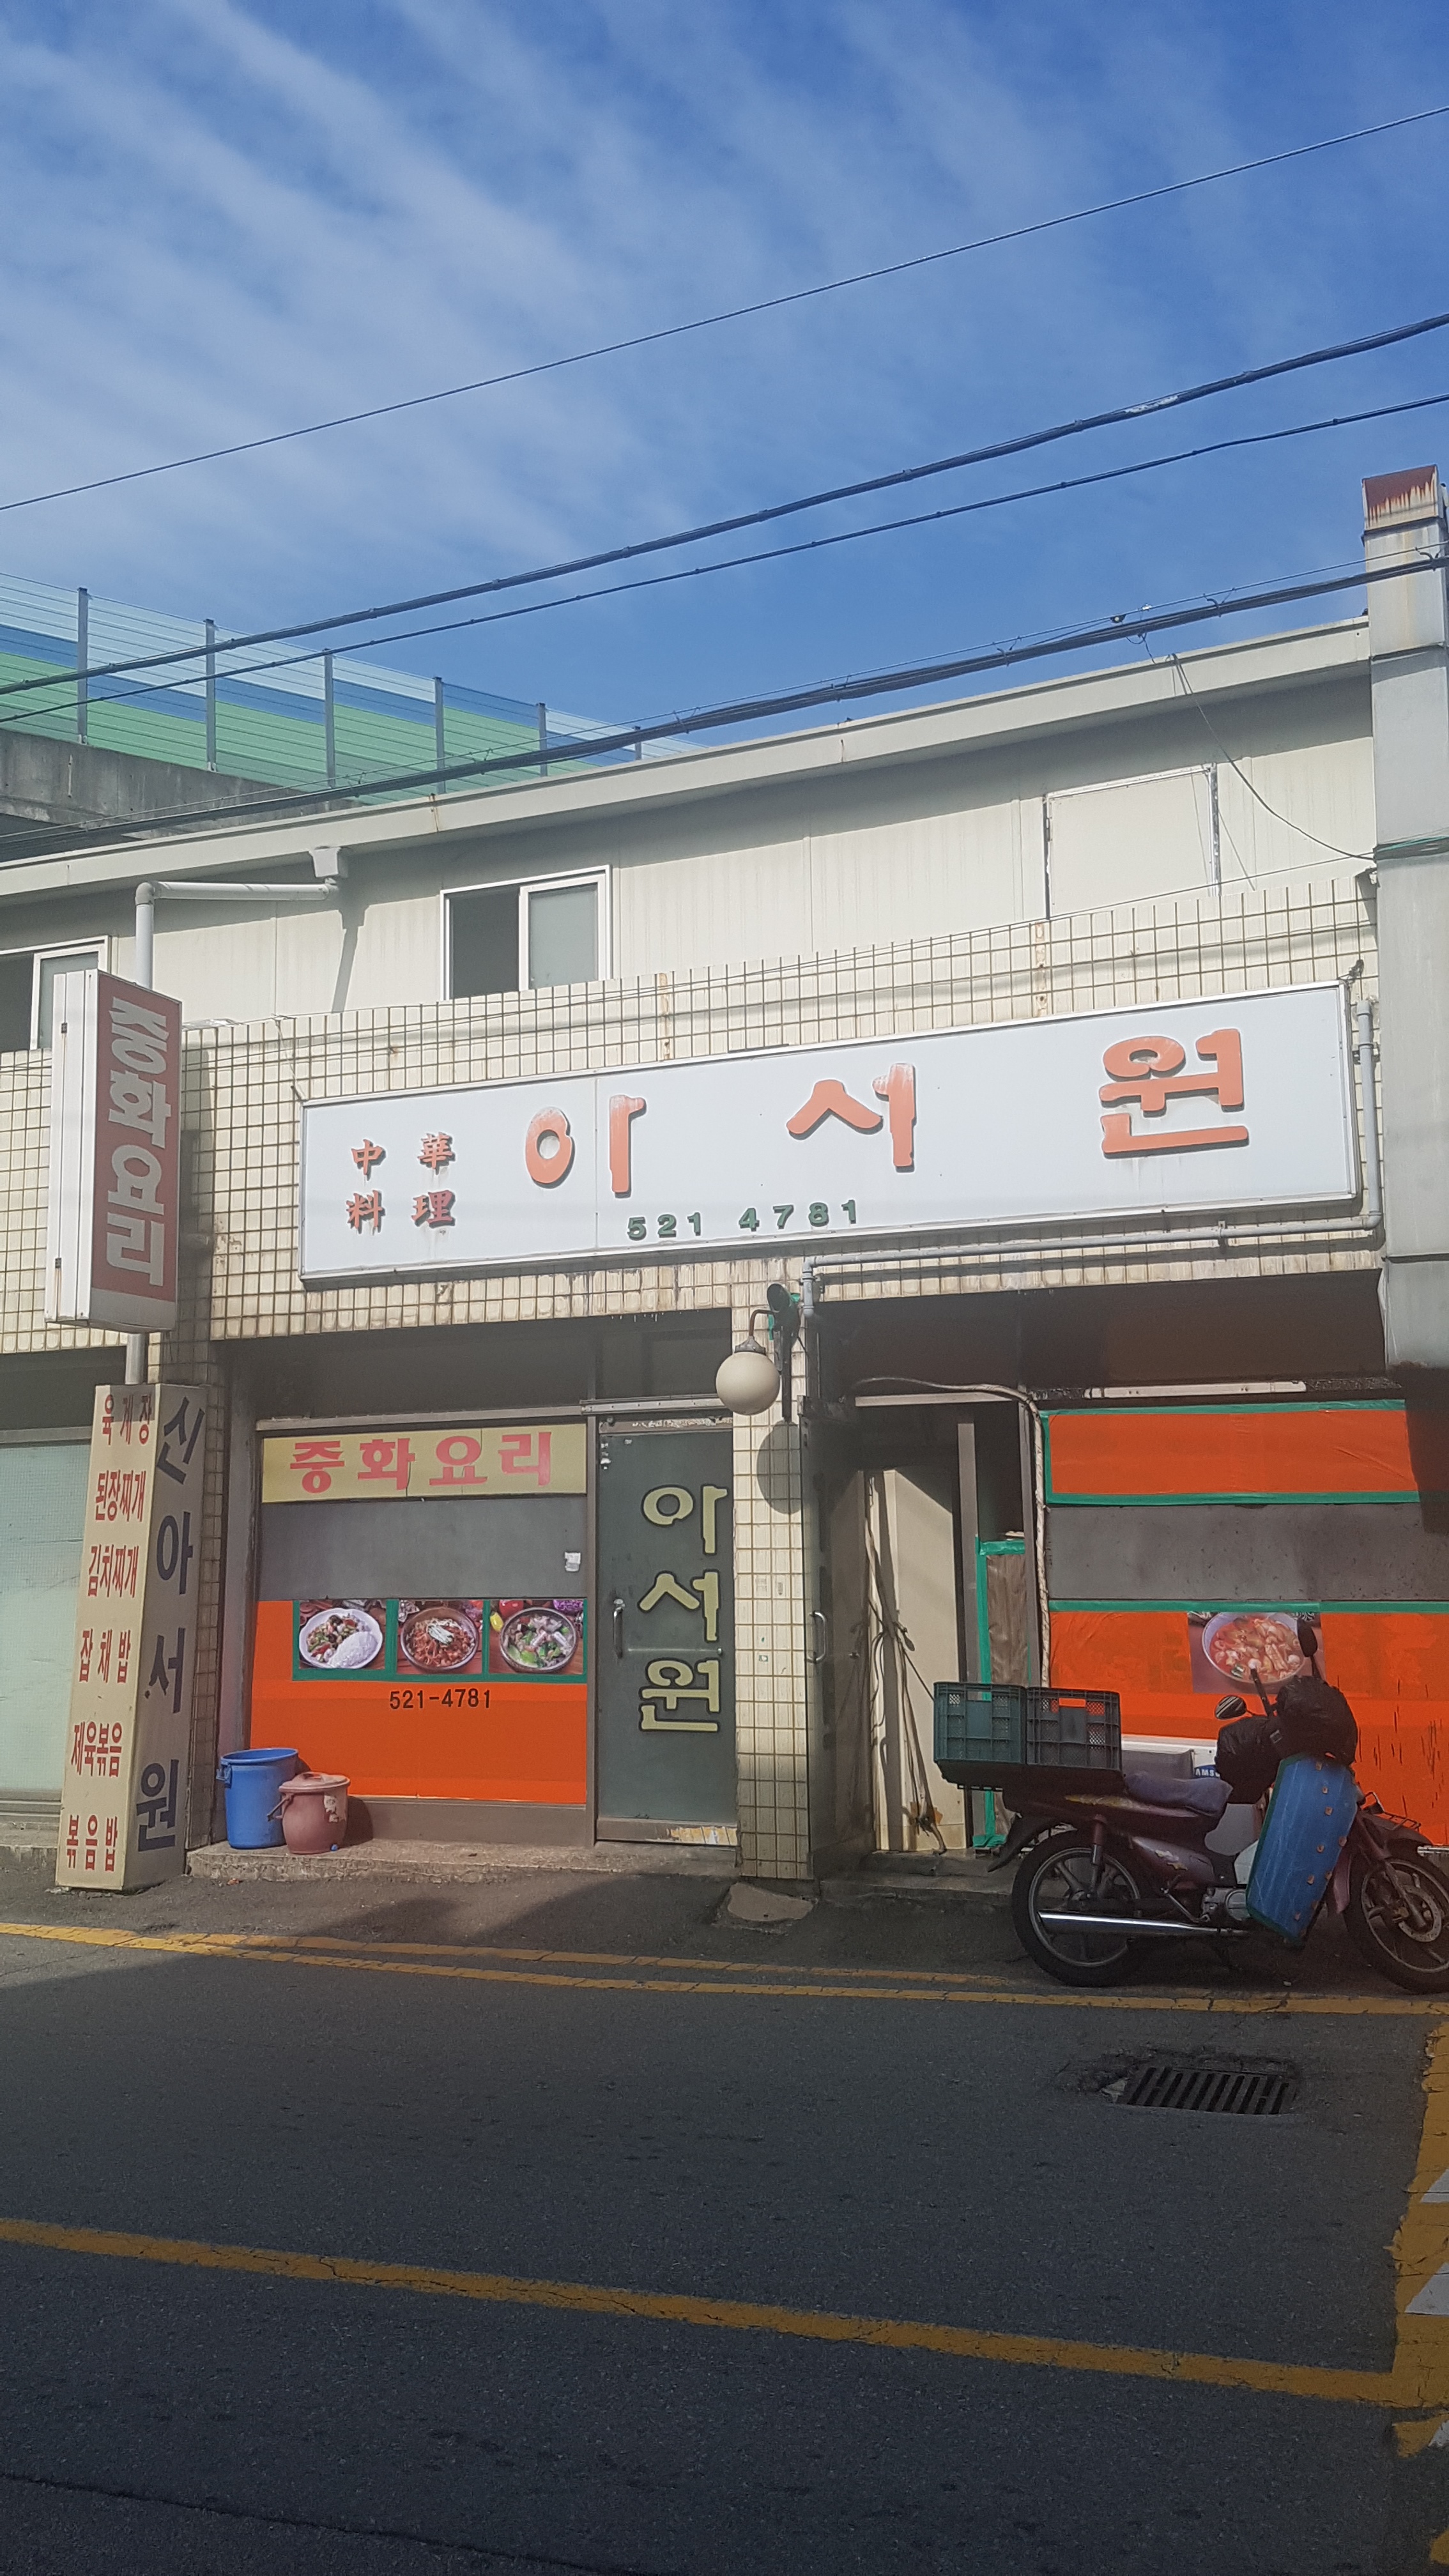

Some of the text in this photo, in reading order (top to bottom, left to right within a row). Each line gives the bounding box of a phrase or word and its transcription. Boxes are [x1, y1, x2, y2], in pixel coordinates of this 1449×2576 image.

[106, 997, 171, 1286] 중화요리
[351, 1131, 455, 1181] 中華
[346, 1190, 455, 1233] 料理
[627, 1199, 857, 1241] 521 4781
[289, 1432, 552, 1494] 중화요리
[95, 1469, 146, 1522] 된장찌개
[88, 1544, 139, 1598] 김치찌개
[79, 1629, 131, 1683] 잡채밥
[389, 1688, 491, 1710] 521-4781
[70, 1721, 123, 1777] 제육볶음
[66, 1814, 118, 1872] 볶음밥
